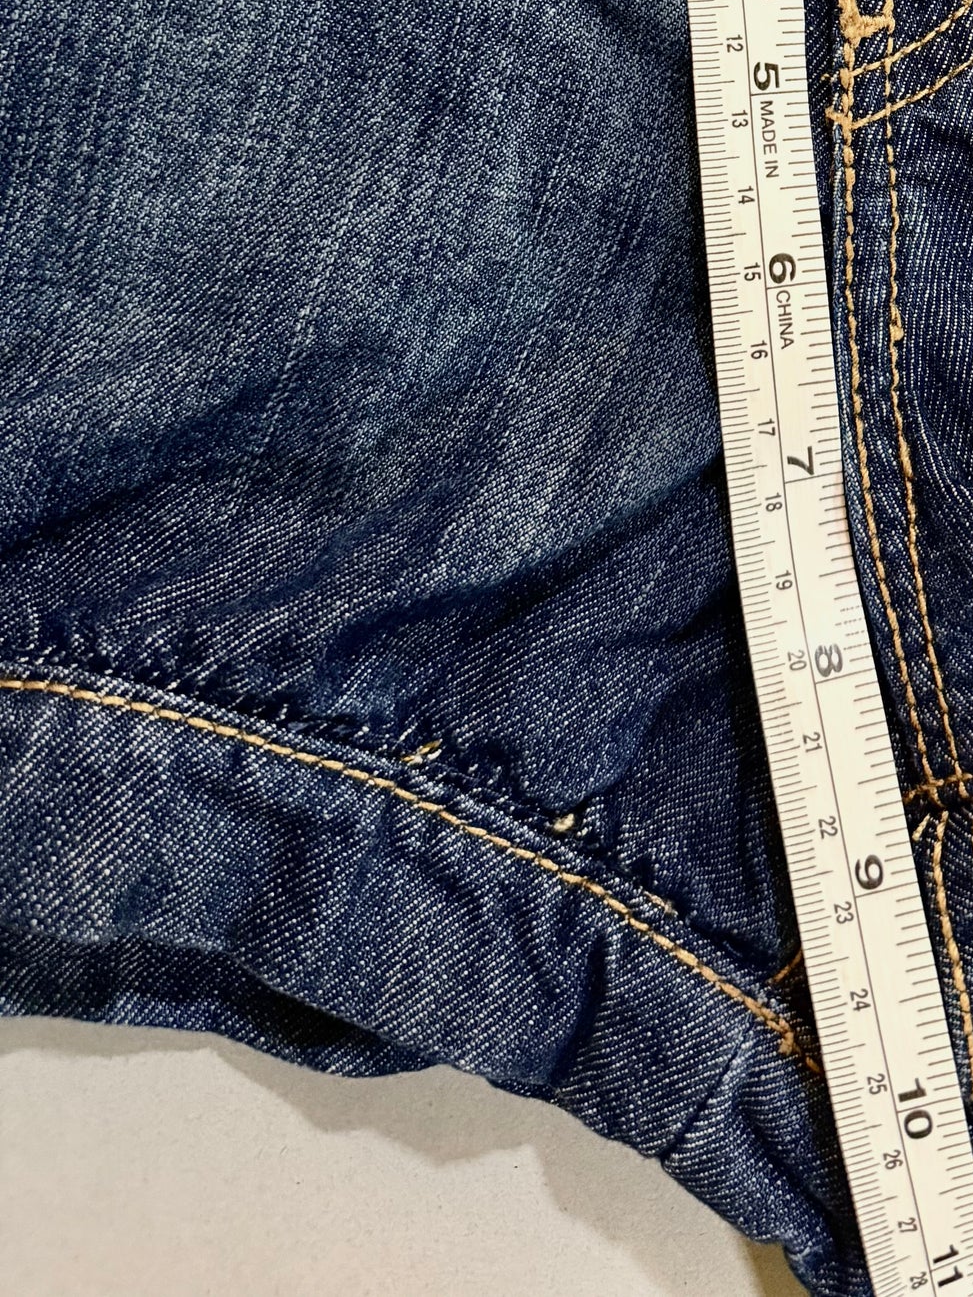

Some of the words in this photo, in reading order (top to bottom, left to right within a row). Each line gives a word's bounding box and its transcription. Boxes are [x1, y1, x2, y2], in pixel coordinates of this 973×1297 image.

[726, 34, 744, 53] 12
[753, 61, 780, 91] 5
[731, 109, 749, 129] 13
[760, 100, 778, 155] MADE
[764, 160, 780, 179] IN
[737, 185, 755, 205] 14
[743, 261, 761, 282] 15
[768, 252, 797, 285] 6
[776, 290, 794, 350] CHINA
[750, 339, 769, 360] 16
[757, 417, 776, 437] 17
[787, 445, 815, 476] 7
[765, 491, 783, 513] 18
[775, 569, 793, 591] 19
[787, 649, 808, 672] 20
[814, 643, 843, 678] 8
[802, 731, 823, 753] 21
[818, 815, 838, 840] 22
[855, 854, 884, 890] 9
[833, 901, 854, 925] 23
[849, 988, 872, 1013] 24
[866, 1073, 888, 1096] 25
[898, 1077, 933, 1140] 10
[882, 1149, 904, 1171] 26
[897, 1217, 918, 1234] 27
[933, 1244, 964, 1288] 11
[909, 1271, 929, 1291] 28
